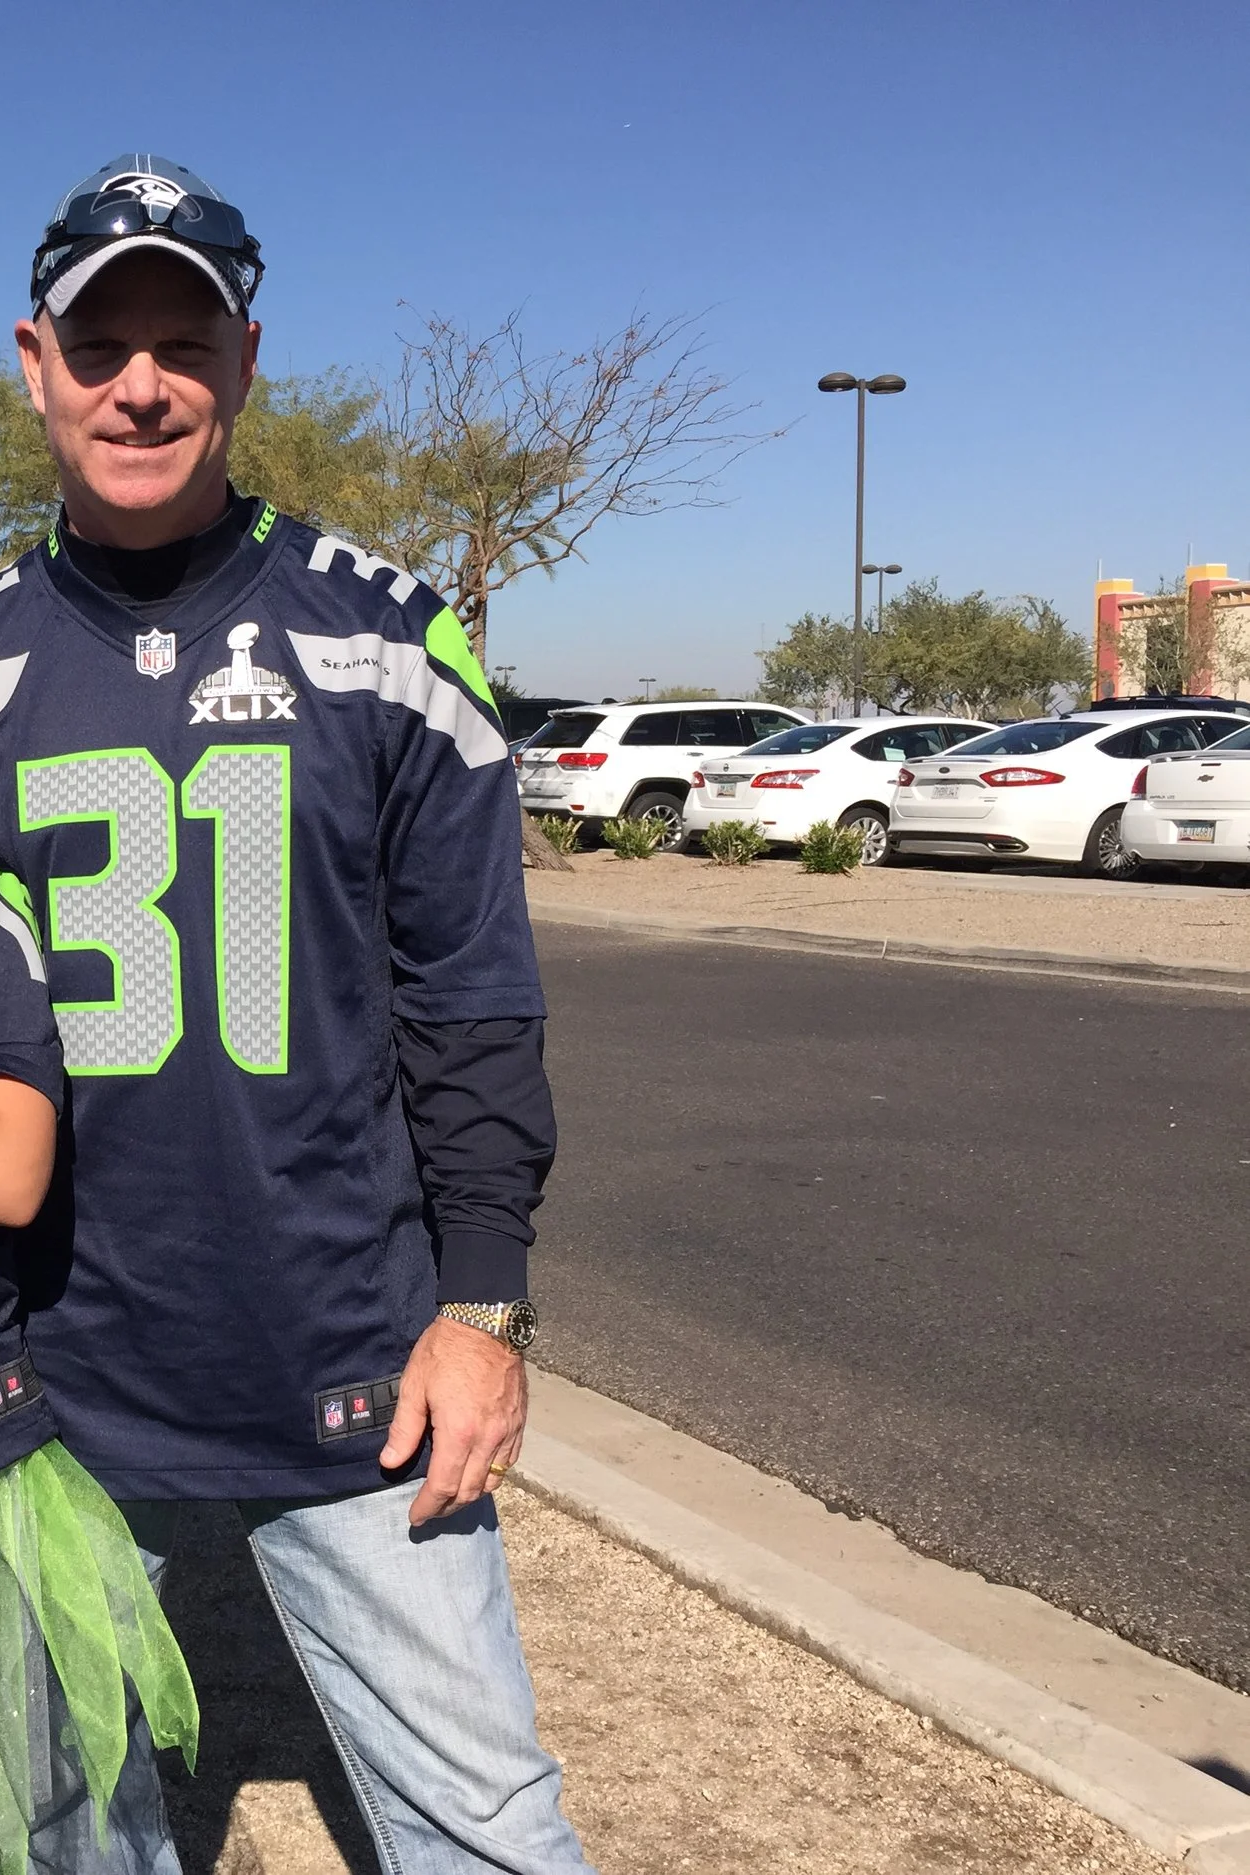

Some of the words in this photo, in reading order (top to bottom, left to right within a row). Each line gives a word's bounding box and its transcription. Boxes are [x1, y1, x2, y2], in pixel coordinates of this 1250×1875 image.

[142, 650, 170, 670] NFL
[320, 657, 391, 676] SEAHAWS
[188, 695, 298, 725] XLIX
[16, 744, 291, 1076] 31
